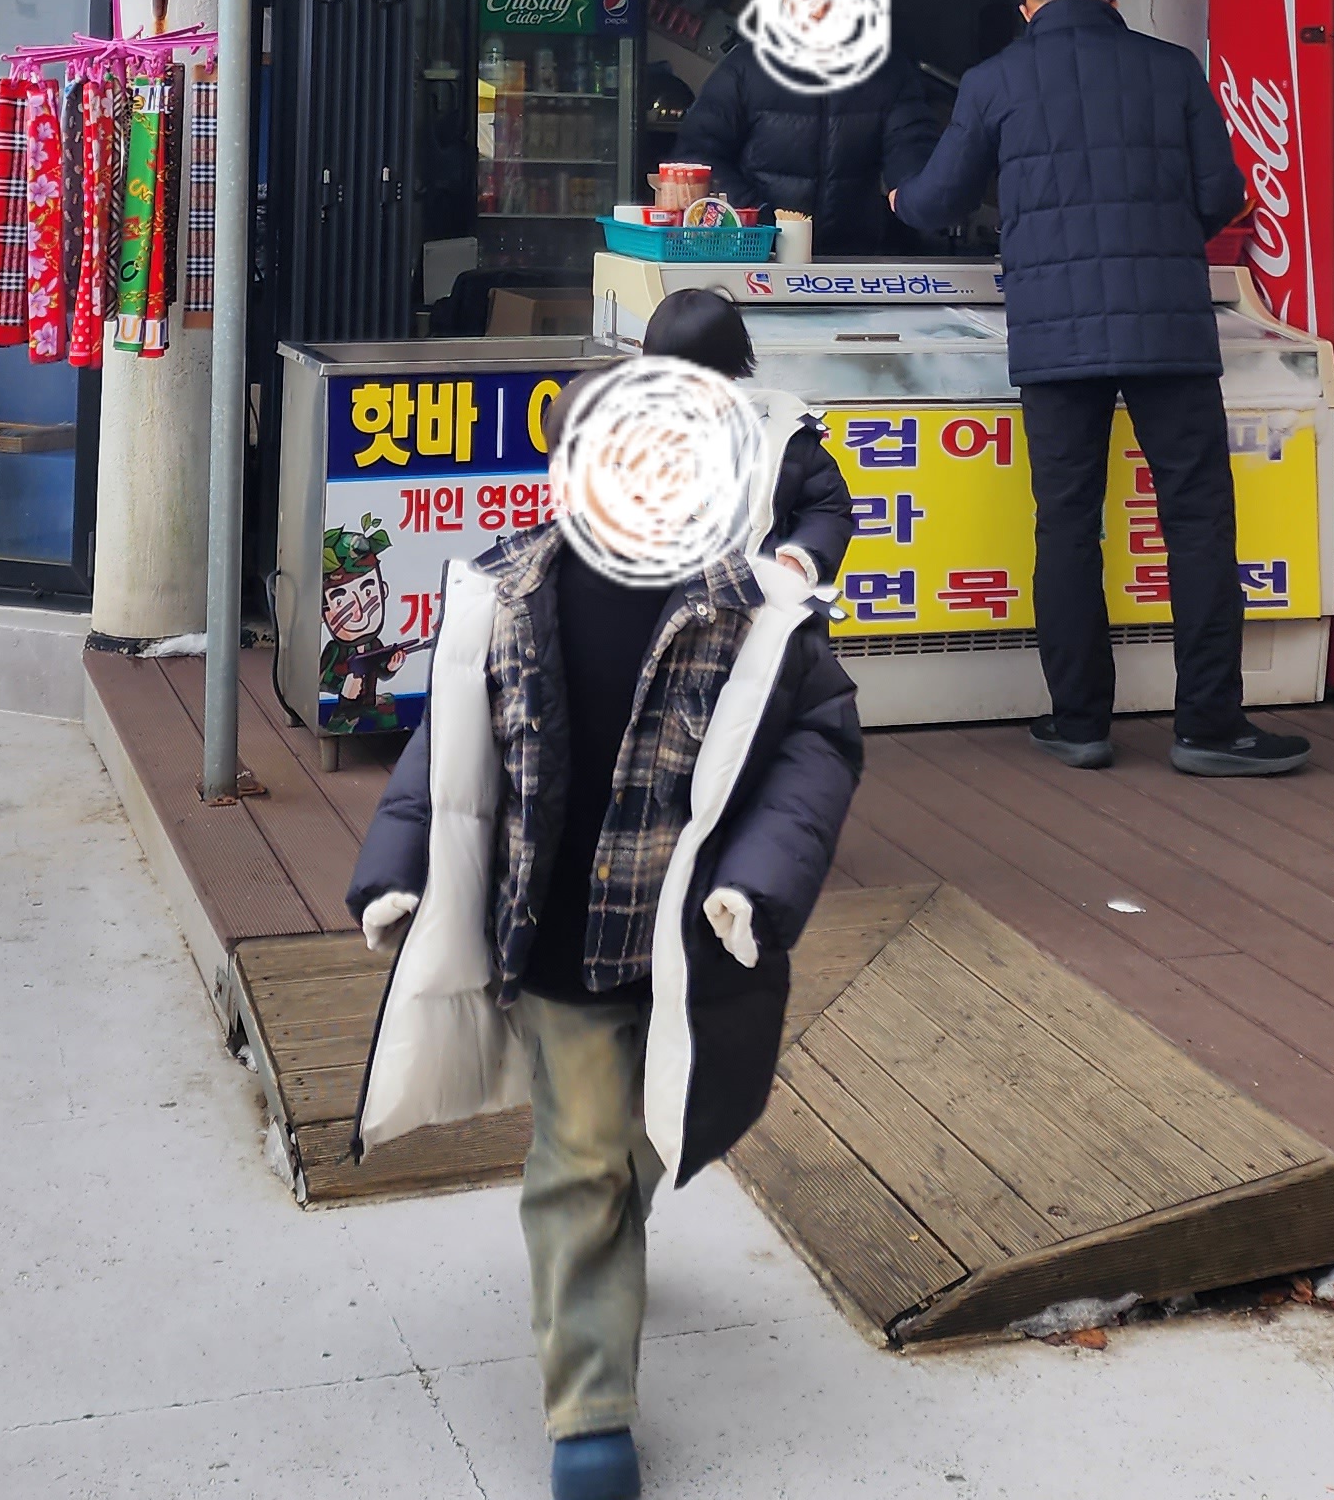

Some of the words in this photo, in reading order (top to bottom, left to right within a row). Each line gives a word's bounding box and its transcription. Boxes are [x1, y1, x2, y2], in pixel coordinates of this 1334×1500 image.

[505, 10, 554, 26] Cider
[786, 273, 858, 295] 맛으로
[351, 381, 479, 468] 핫바
[399, 486, 464, 533] 개인
